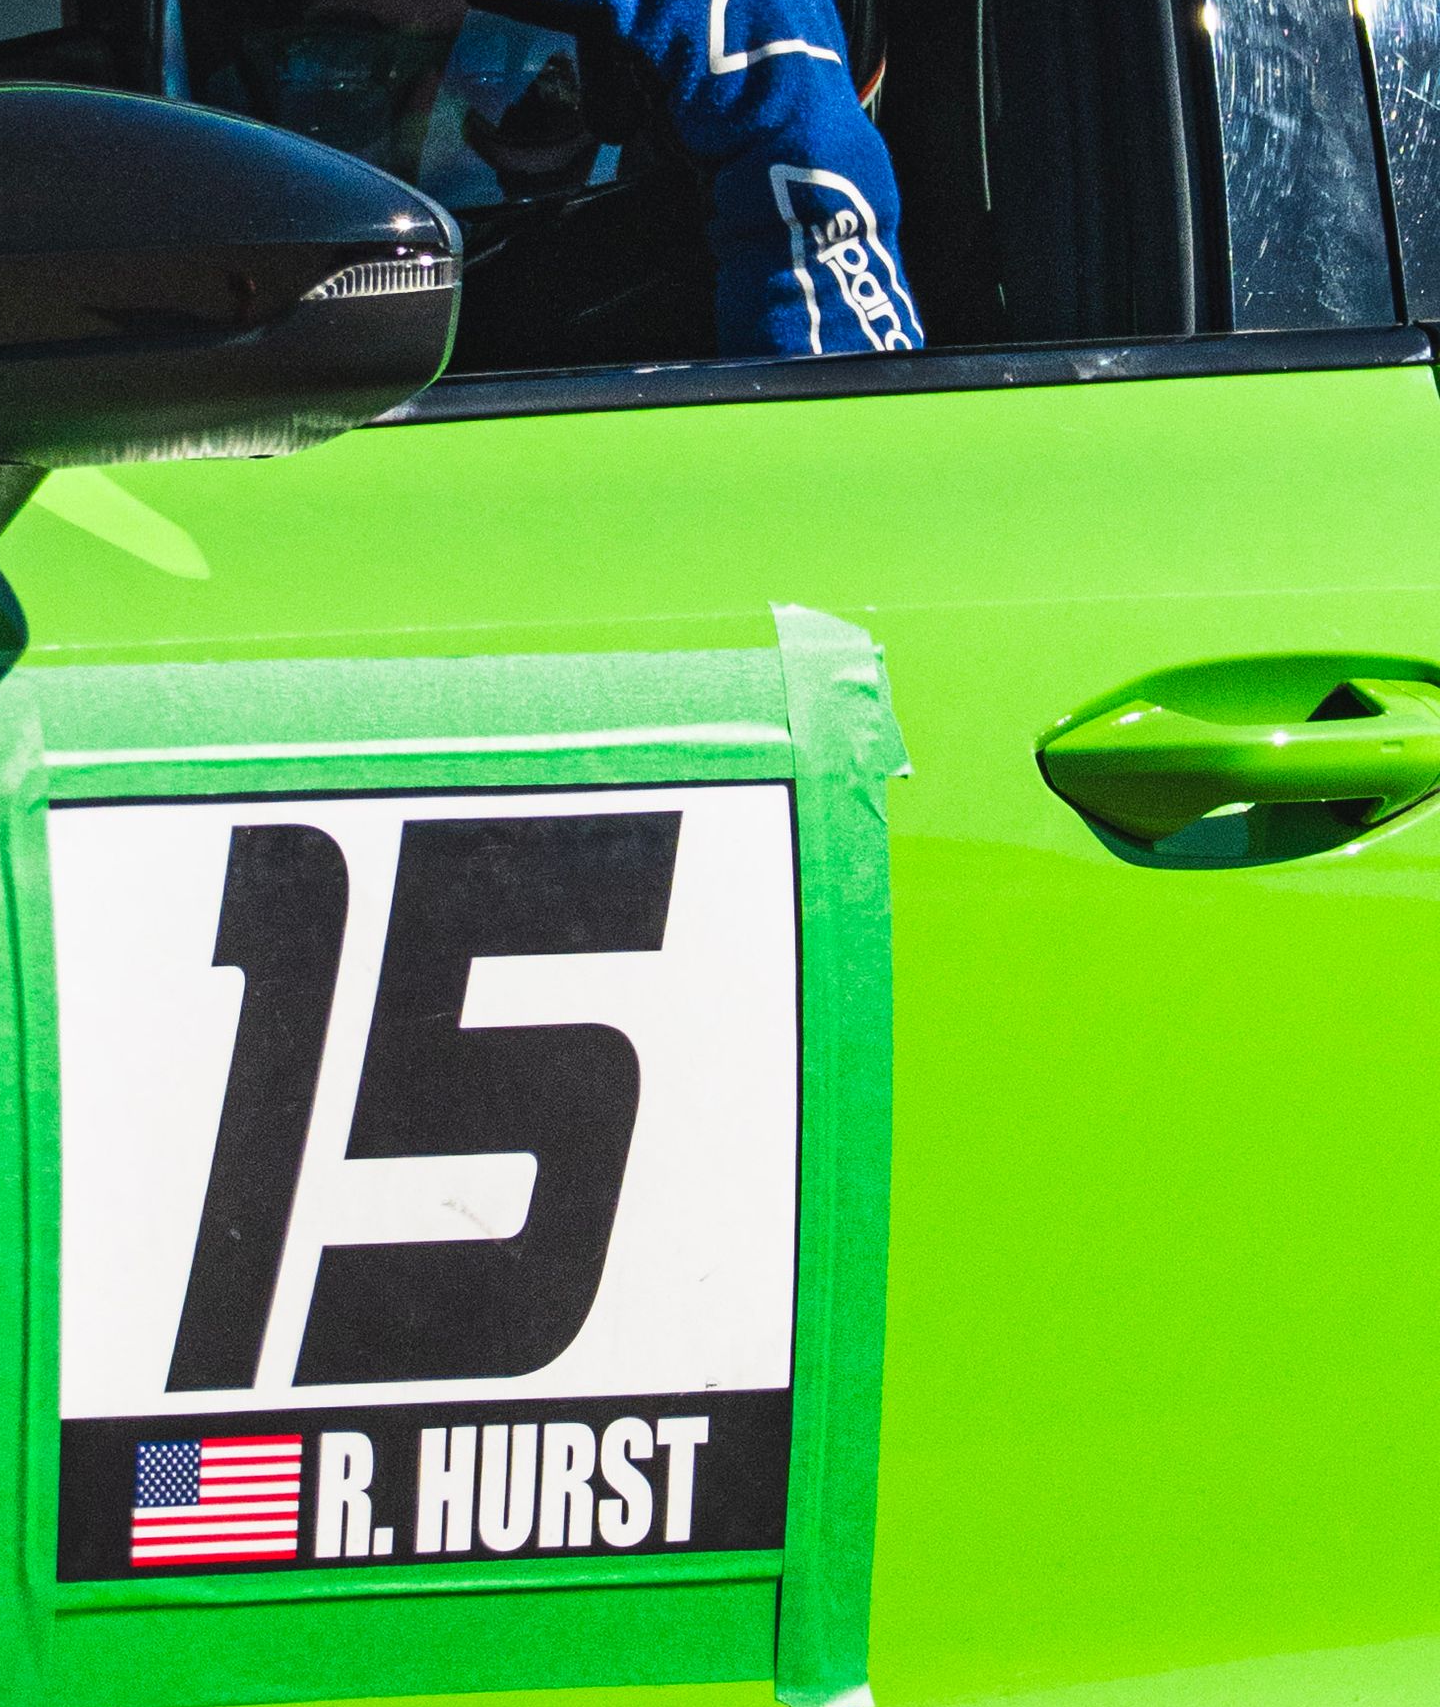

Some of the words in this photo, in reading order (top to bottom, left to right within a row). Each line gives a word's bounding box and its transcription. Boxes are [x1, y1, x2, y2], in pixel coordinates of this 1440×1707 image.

[164, 809, 683, 1393] 15
[314, 1431, 394, 1558] R.
[414, 1415, 710, 1554] HURST
